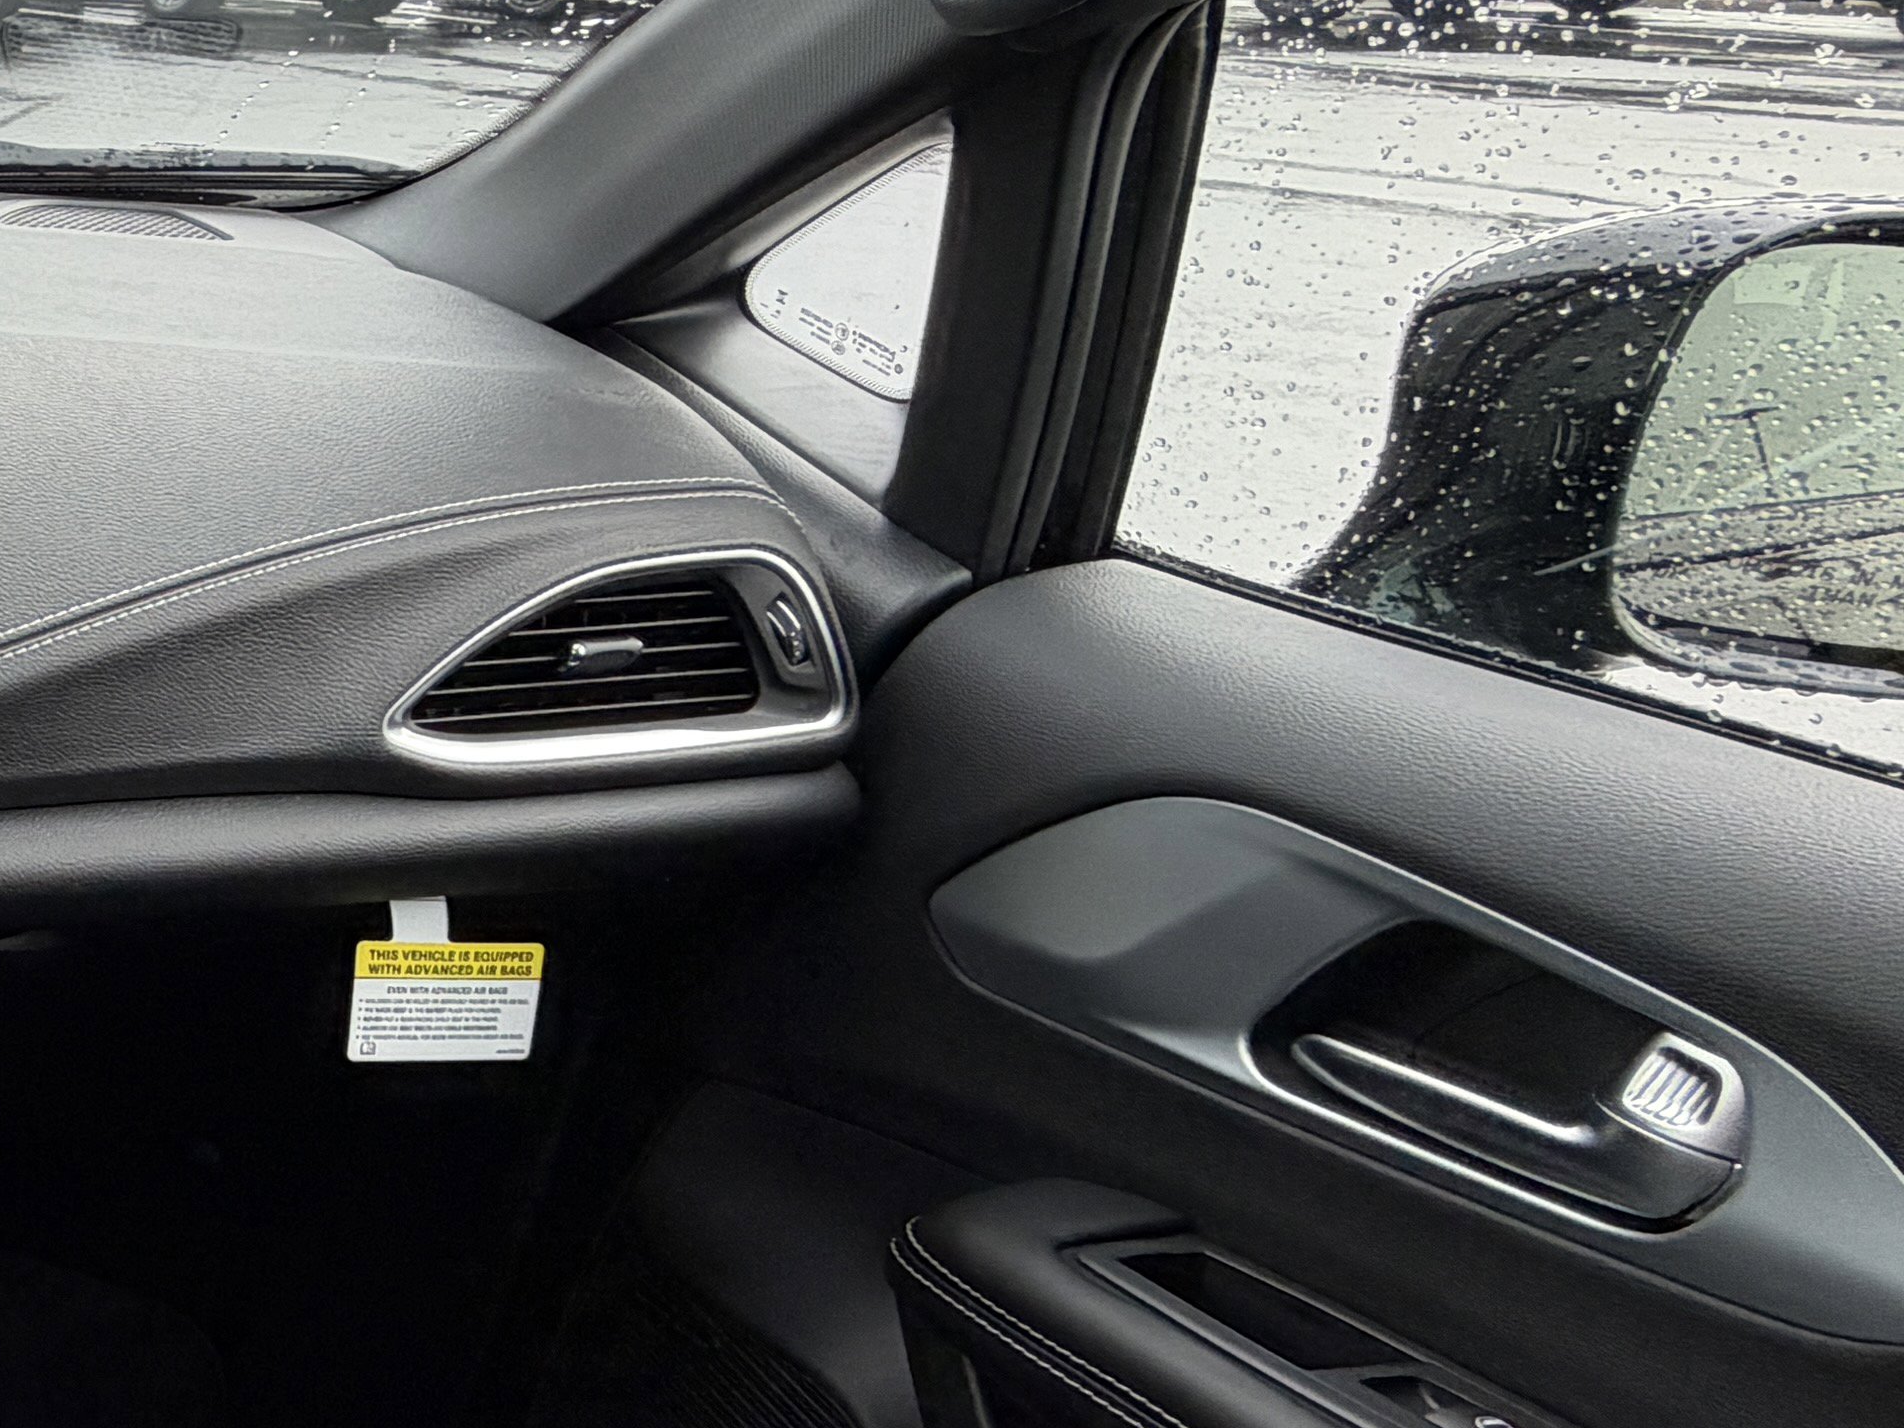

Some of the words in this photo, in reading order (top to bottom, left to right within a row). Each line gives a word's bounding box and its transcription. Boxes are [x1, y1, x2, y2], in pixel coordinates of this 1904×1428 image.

[369, 949, 399, 961] THIS
[402, 950, 456, 962] VEHICLE
[458, 951, 471, 962] IS
[473, 951, 534, 963] EQUIPPED
[368, 963, 402, 975] WITH
[405, 964, 474, 976] ADVANCED
[476, 965, 498, 976] AIR
[500, 965, 533, 977] BAGS
